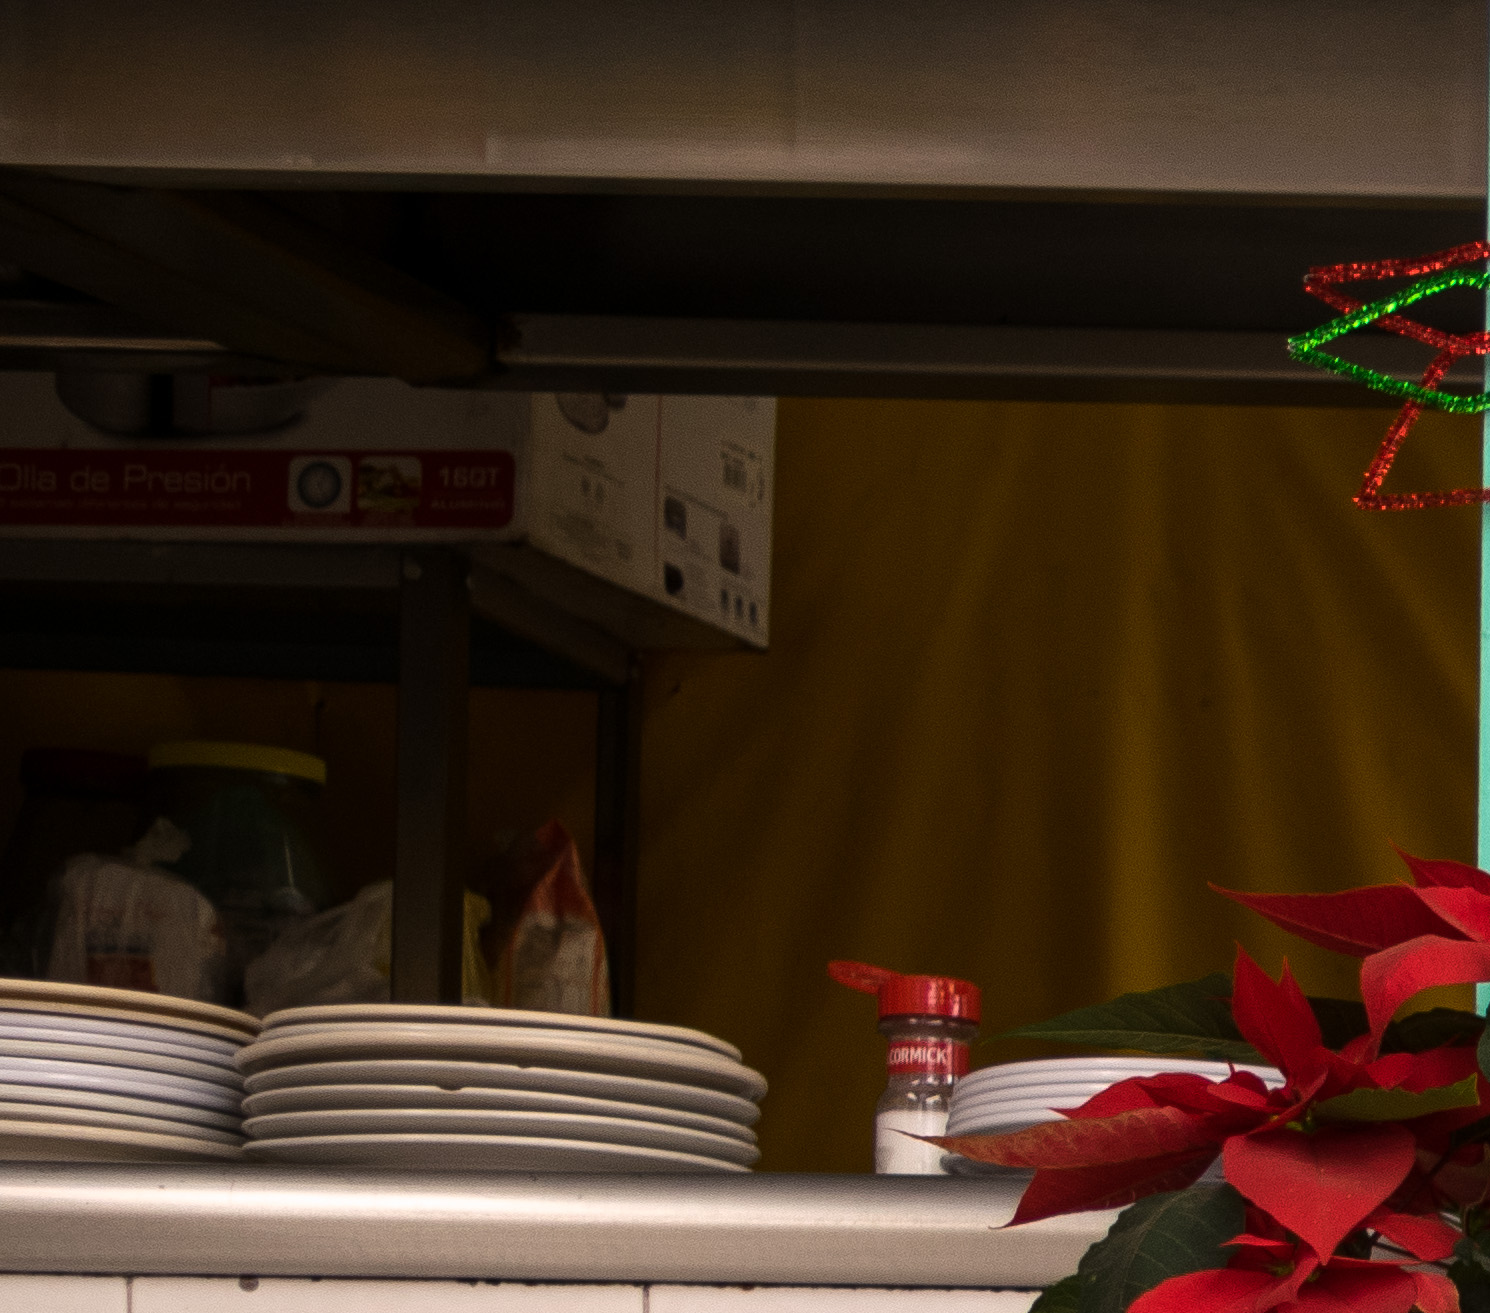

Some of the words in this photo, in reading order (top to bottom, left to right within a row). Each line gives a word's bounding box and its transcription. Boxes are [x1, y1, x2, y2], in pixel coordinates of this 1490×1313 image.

[0, 462, 57, 493] Olla
[69, 464, 111, 493] de
[123, 461, 252, 493] Presión
